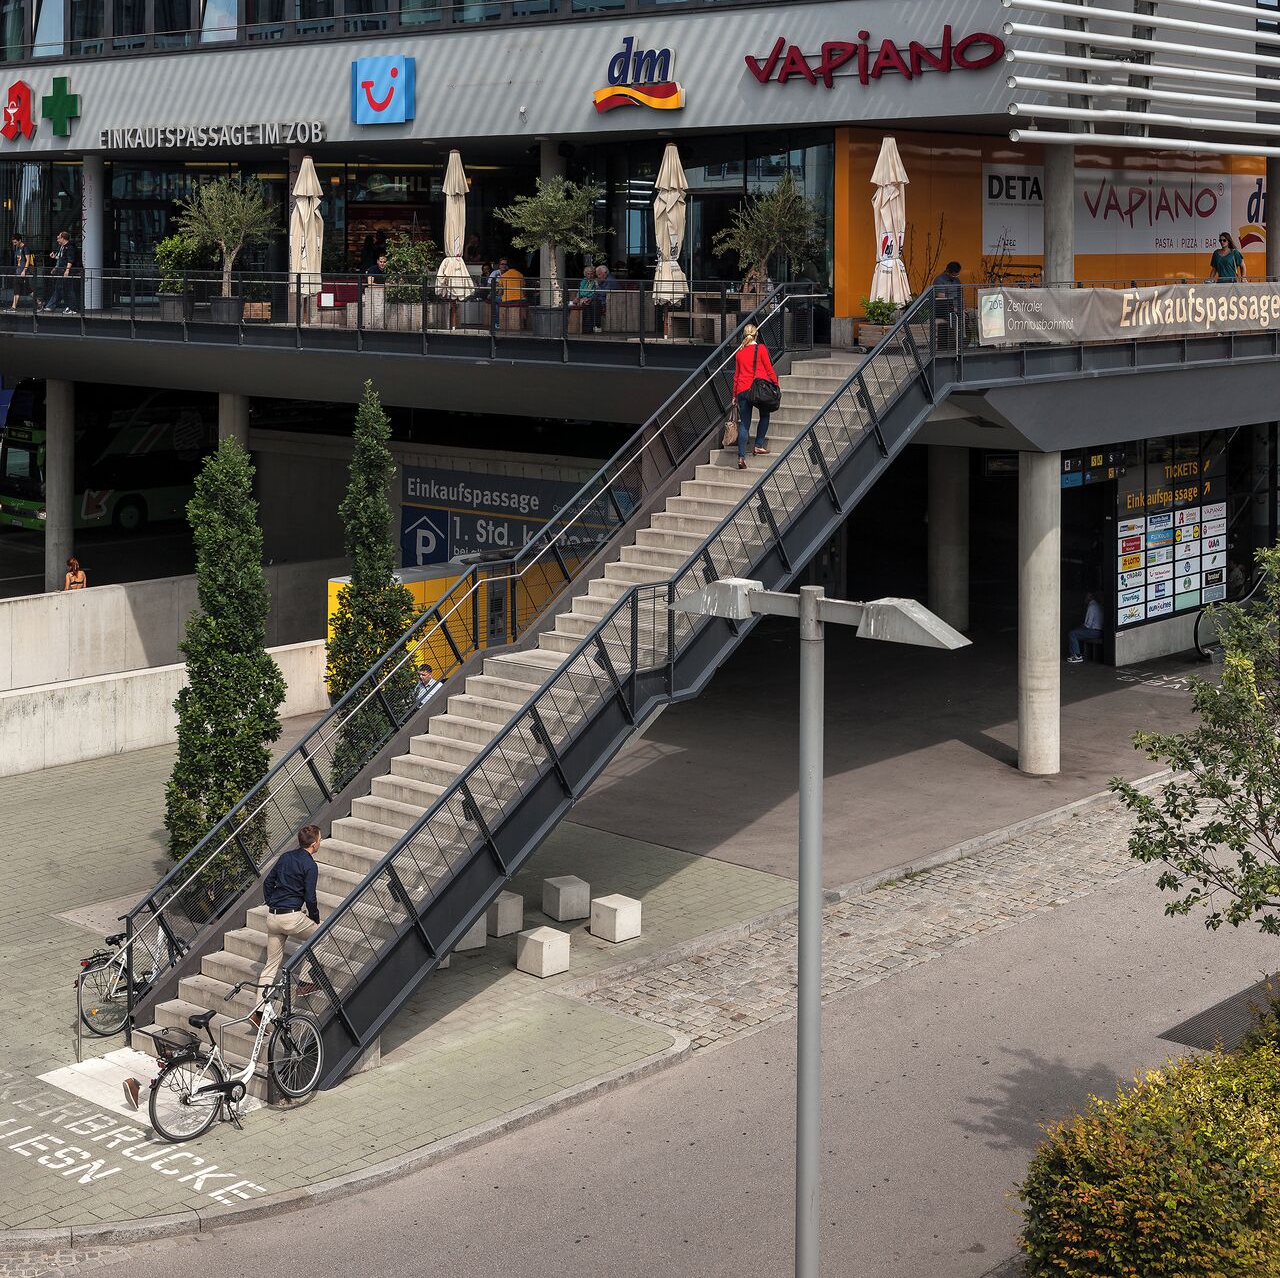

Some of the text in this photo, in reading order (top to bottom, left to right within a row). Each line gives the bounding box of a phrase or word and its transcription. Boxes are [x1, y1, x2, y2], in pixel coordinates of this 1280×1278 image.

[607, 36, 673, 86] dm
[744, 24, 1006, 89] VAPIANO
[99, 121, 323, 149] EINKAUFSPASSAGE IM ZOB
[1155, 238, 1217, 249] PASTA PIZZA BAR
[1007, 299, 1043, 313] Zentraler
[1007, 318, 1075, 331] Omnibusbahnhof
[1164, 462, 1198, 479] TICKETS
[407, 478, 540, 513] Einkaufspassage
[1127, 486, 1198, 510] Einkaufspassage
[453, 517, 468, 541] 1.
[476, 520, 514, 547] Std.
